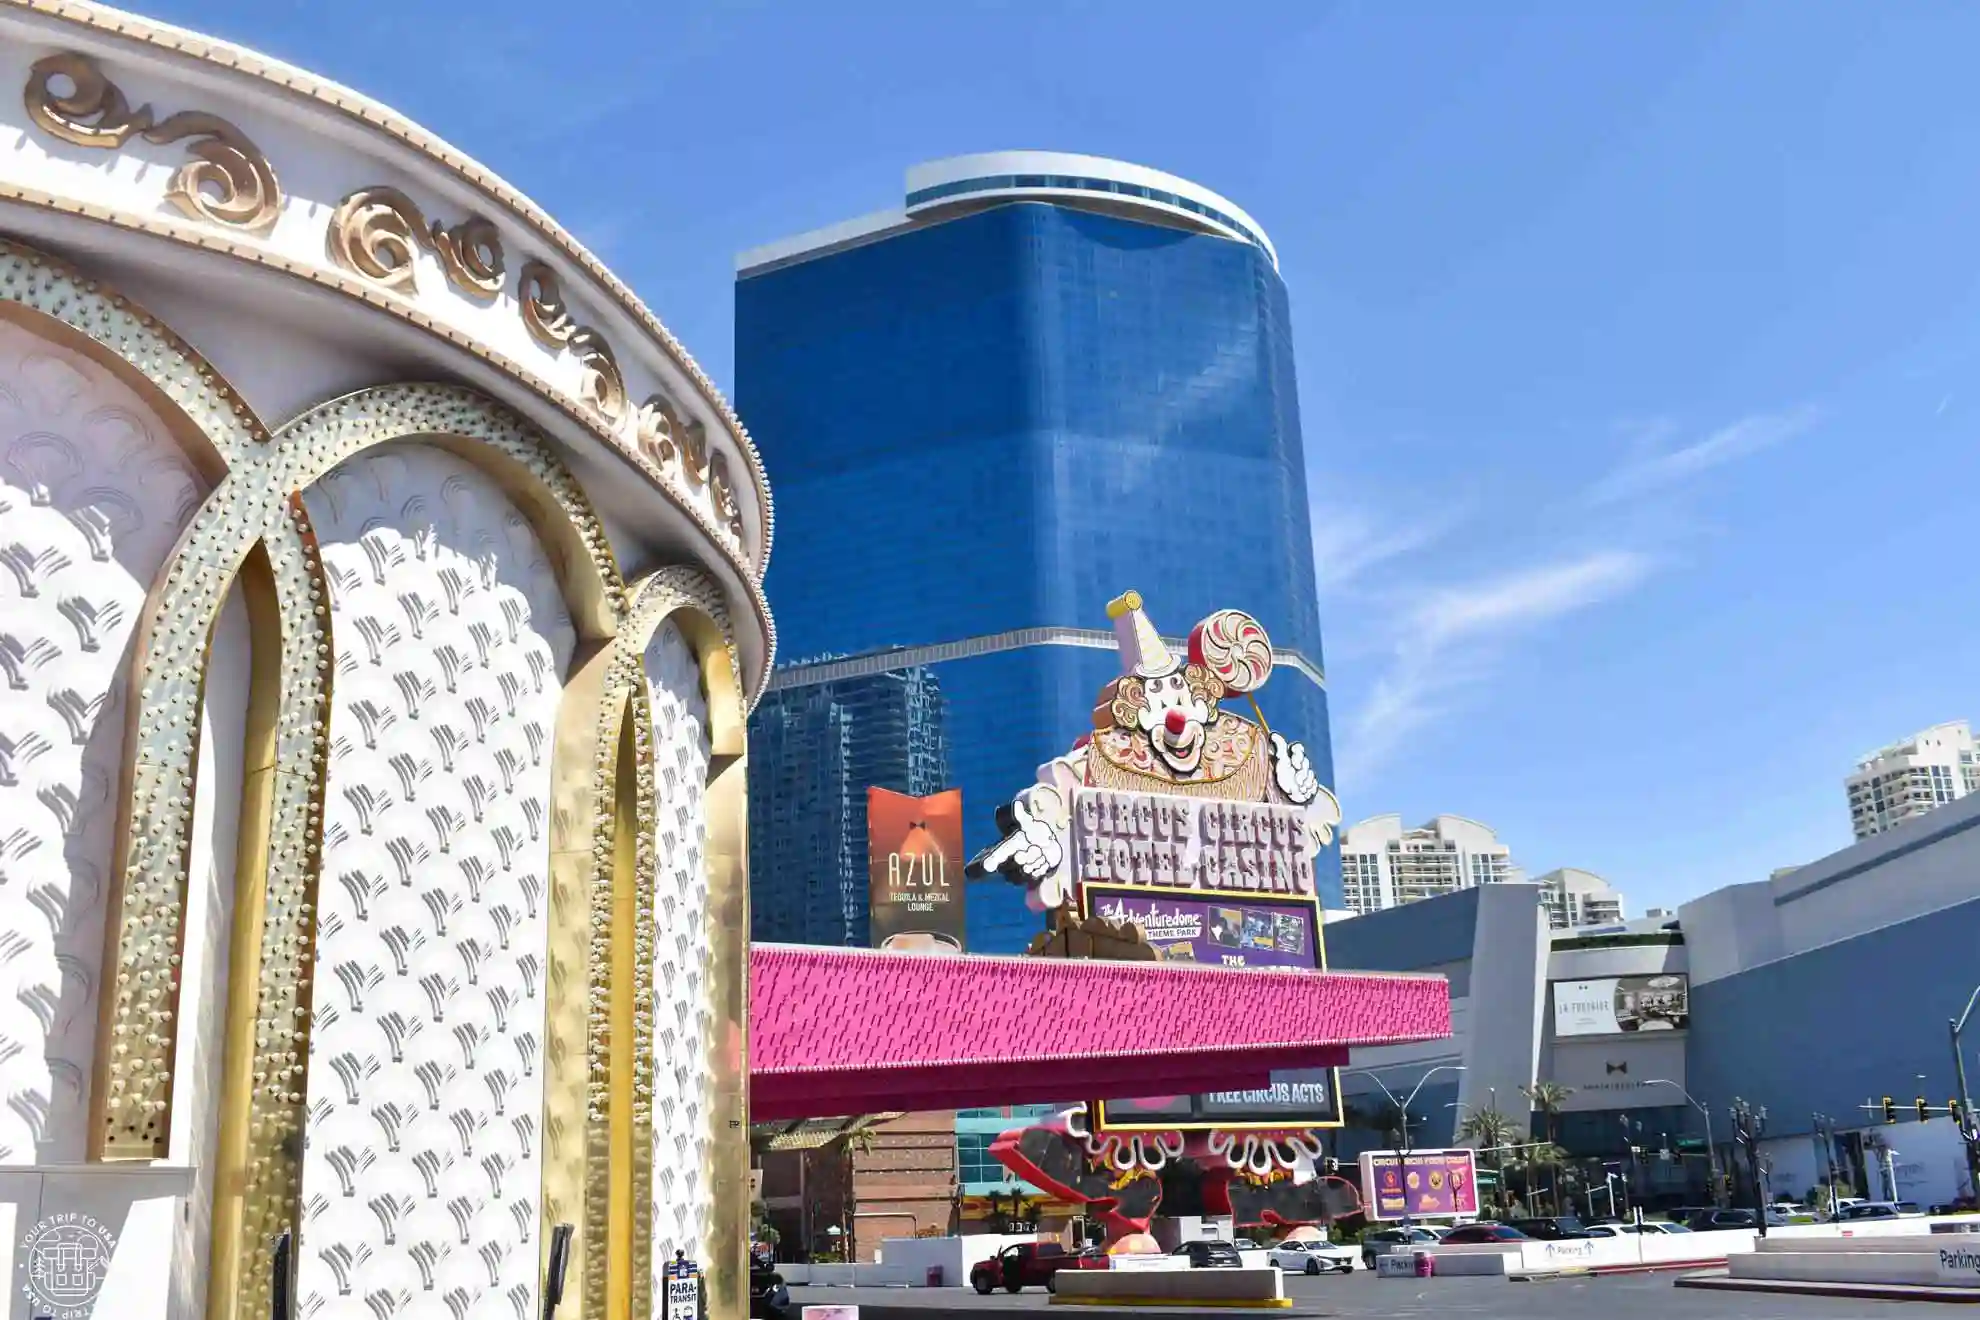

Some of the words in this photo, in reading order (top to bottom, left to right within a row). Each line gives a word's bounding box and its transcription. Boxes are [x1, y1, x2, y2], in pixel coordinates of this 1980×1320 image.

[1078, 790, 1193, 842] CIRCUS
[1199, 802, 1309, 852] CIRCUS
[888, 851, 950, 887] AZUL
[1080, 836, 1199, 887] HOTEL
[1199, 845, 1315, 895] CASINO
[907, 902, 934, 912] LOUNGE
[1148, 930, 1174, 938] THEME
[1176, 928, 1197, 937] PARK
[1291, 1083, 1325, 1104] ACTS
[1940, 1248, 1980, 1275] Parking
[670, 1282, 697, 1295] PARA-
[670, 1293, 697, 1304] TRANSIT
